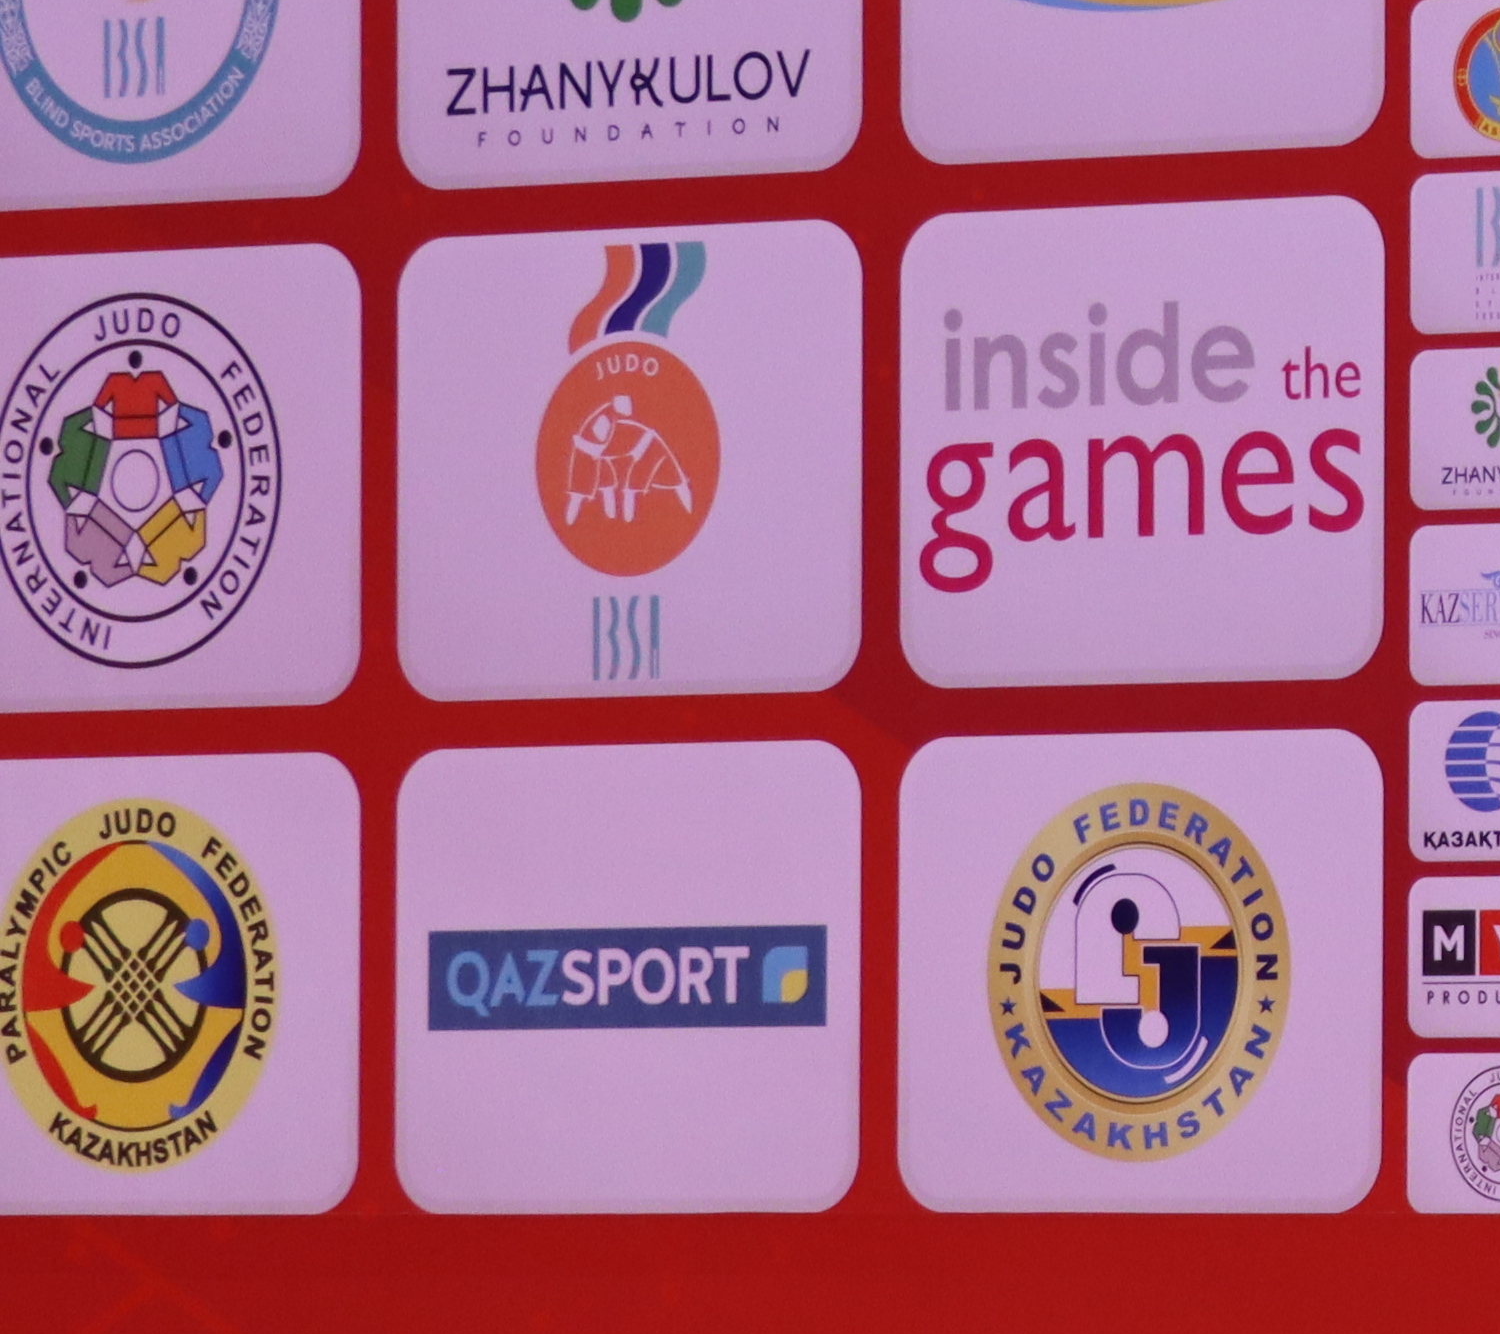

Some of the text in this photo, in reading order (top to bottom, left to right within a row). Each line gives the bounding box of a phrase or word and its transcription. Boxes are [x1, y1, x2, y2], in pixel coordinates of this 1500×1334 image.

[24, 66, 246, 154] BLIND SPORTS ASSOCIATION
[445, 48, 812, 119] ZHANYKULOV
[477, 117, 782, 148] FOUNDATION
[94, 308, 182, 342] JUDO
[596, 353, 661, 380] JUDO
[943, 300, 1363, 412] inside the
[1, 362, 113, 651] INTERNATIONAL
[199, 360, 271, 621] FEDERATION
[918, 427, 1366, 592] games
[99, 808, 178, 840] JUDO
[999, 853, 1056, 985] JUDO
[1072, 798, 1279, 981] FEDERATION
[0, 840, 73, 1065] PARALYMPIC
[200, 836, 275, 1061] FEDERATION
[446, 945, 751, 1016] QAZSPORT
[48, 1110, 219, 1168] KAZAKHSTAN
[1004, 1023, 1272, 1151] KAZAKHSTAN
